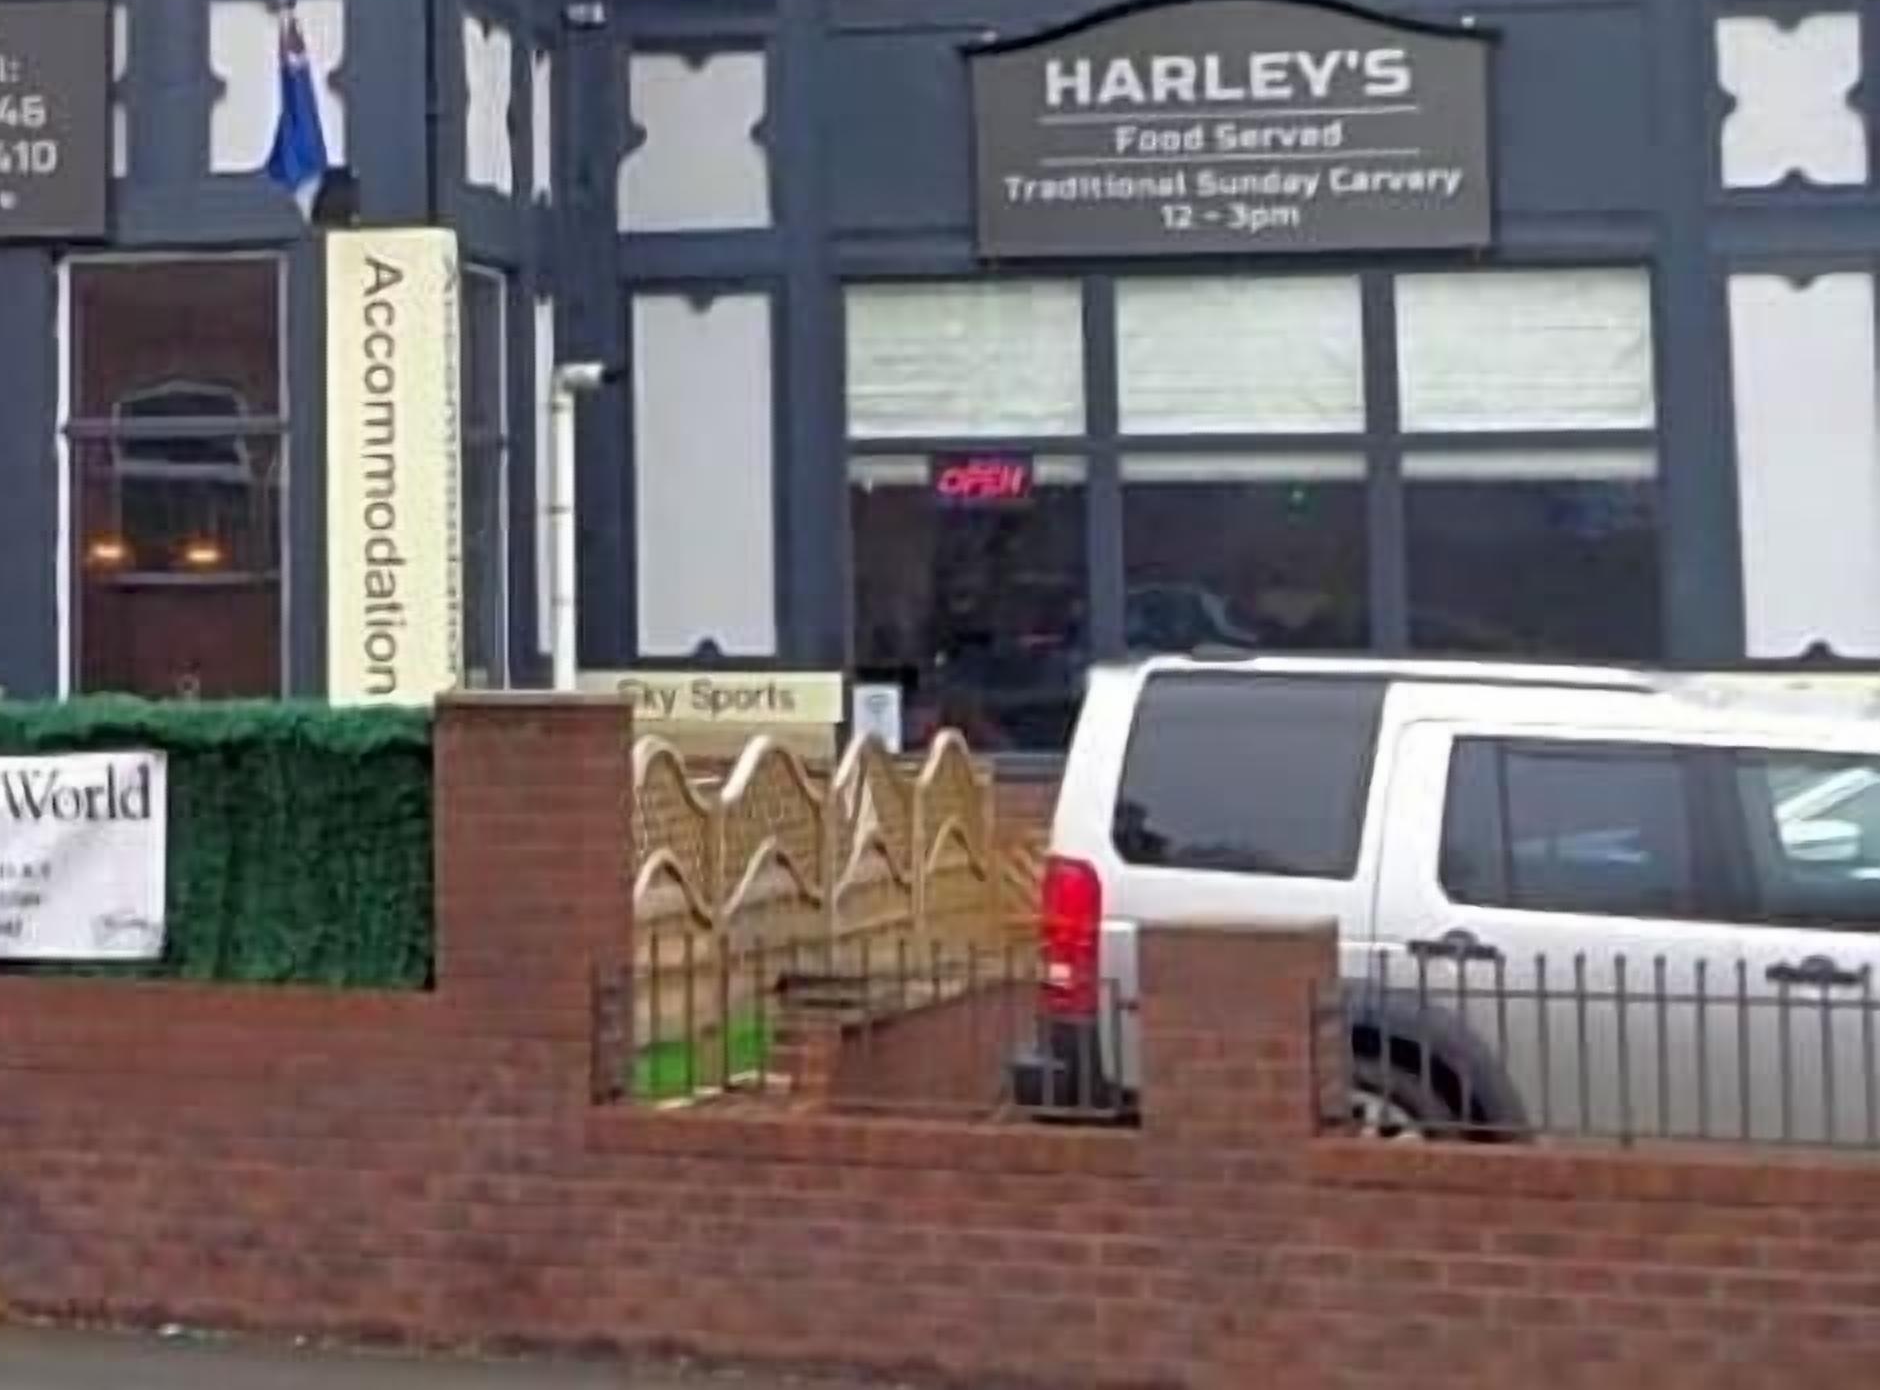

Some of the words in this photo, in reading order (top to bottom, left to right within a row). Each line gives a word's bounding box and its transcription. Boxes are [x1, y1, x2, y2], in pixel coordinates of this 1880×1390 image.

[1046, 48, 1412, 107] HARLEY'S
[1115, 125, 1203, 154] Food
[1219, 121, 1343, 151] Served
[1004, 170, 1186, 202] Traditional
[1197, 168, 1320, 200] Sunday
[1330, 165, 1463, 196] Carvery
[1161, 204, 1193, 229] 12
[1227, 202, 1299, 233] 3pm
[361, 255, 407, 698] Accommodation
[937, 465, 1025, 496] OPEN
[691, 677, 796, 722] Sports
[1, 762, 152, 822] World
